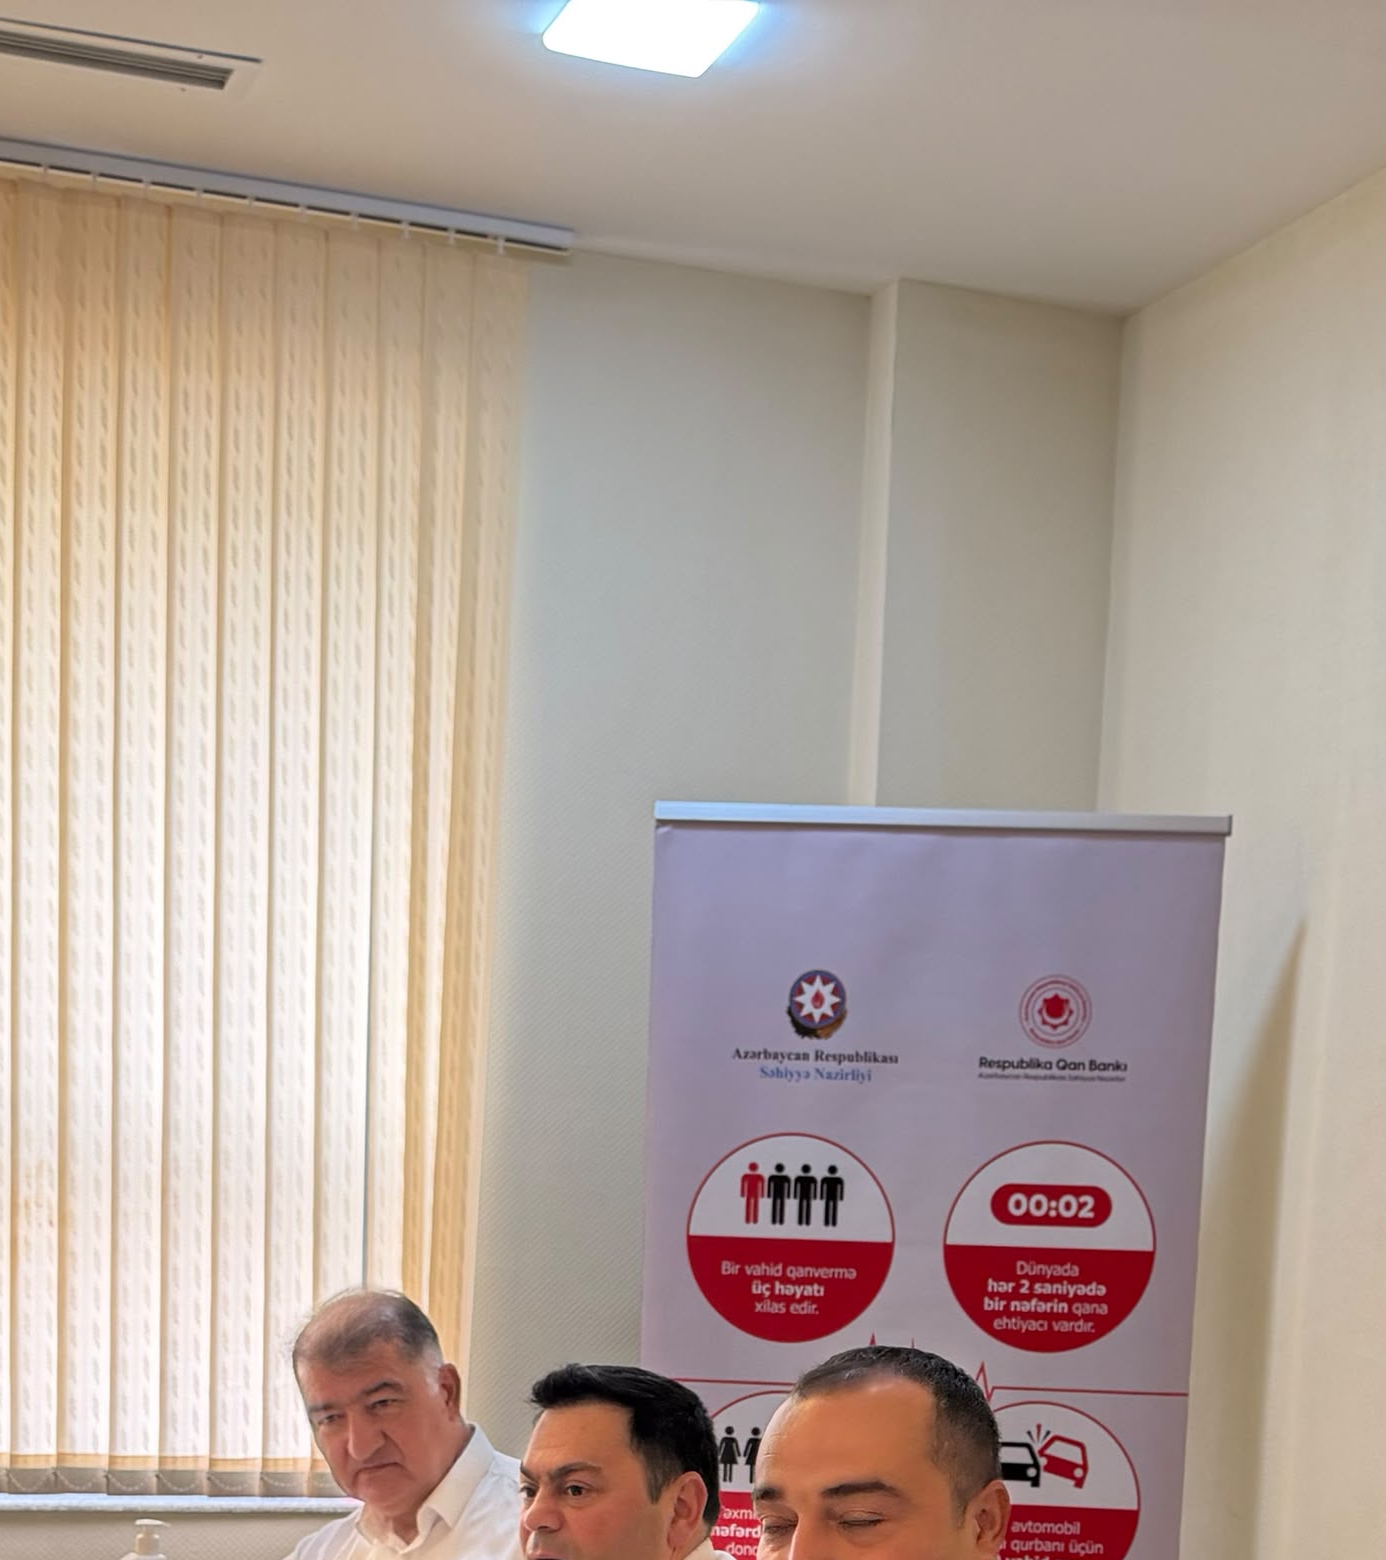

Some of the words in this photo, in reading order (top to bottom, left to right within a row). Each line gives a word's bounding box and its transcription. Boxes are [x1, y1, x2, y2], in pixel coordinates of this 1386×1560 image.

[732, 1048, 810, 1064] Azərbaycan
[814, 1050, 899, 1066] Respublikası
[978, 1057, 1053, 1072] Respublika
[1056, 1058, 1086, 1071] Qan
[1089, 1059, 1128, 1072] Bankı
[1007, 1192, 1095, 1219] 00:02
[721, 1261, 741, 1276] Bir
[745, 1263, 783, 1277] vahid
[786, 1266, 857, 1281] qanvermə
[1016, 1260, 1080, 1279] Dünyada
[751, 1281, 772, 1297] üç
[775, 1281, 825, 1299] həyatı
[987, 1278, 1015, 1293] hər
[1019, 1279, 1030, 1294] 2
[1033, 1280, 1107, 1298] saniyədə
[754, 1299, 786, 1314] xilas
[789, 1301, 820, 1315] edir.
[983, 1297, 1007, 1311] bir
[1010, 1298, 1069, 1314] nəfərin
[1071, 1302, 1109, 1317] qana
[993, 1316, 1048, 1333] ehtiyacı
[1052, 1319, 1096, 1333] vardır.
[711, 1523, 762, 1539] nəfərd
[1011, 1520, 1081, 1535] avtomobil
[1010, 1538, 1065, 1553] qurbanı
[1068, 1540, 1104, 1557] üçün
